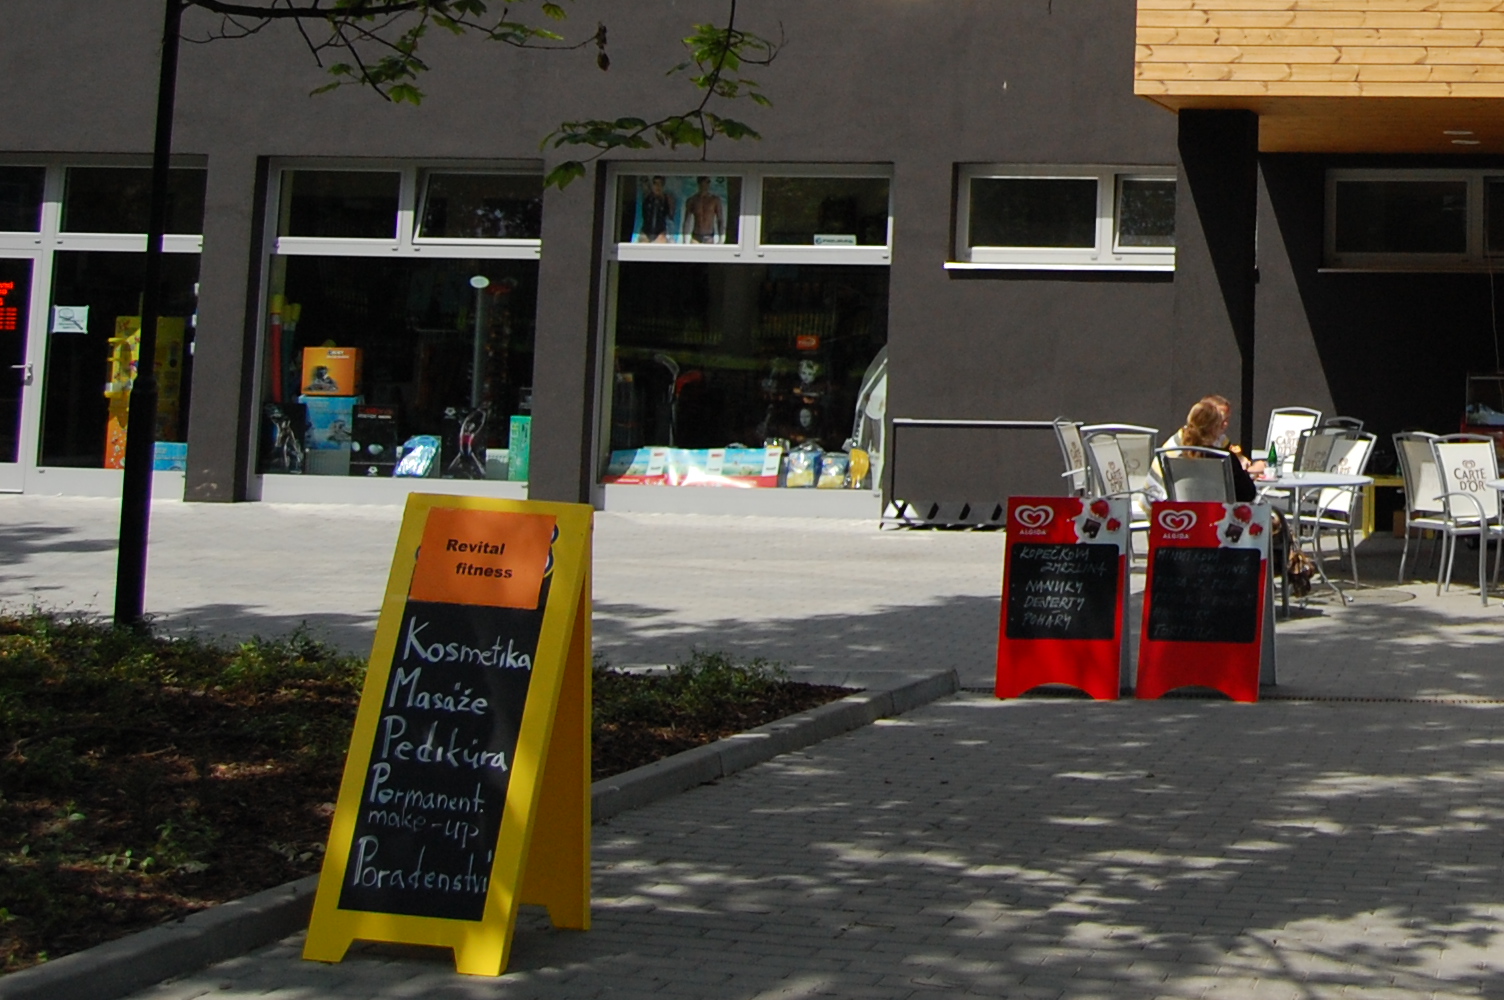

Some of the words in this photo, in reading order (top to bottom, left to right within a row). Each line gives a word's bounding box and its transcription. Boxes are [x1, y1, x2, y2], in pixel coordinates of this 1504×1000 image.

[1453, 467, 1486, 482] CARTE
[1459, 479, 1486, 493] D'OR
[1019, 528, 1047, 536] ALGIDA
[1162, 532, 1190, 540] ALGIDA
[446, 538, 506, 555] Revital
[455, 562, 513, 579] fitness
[1026, 579, 1084, 595] NANUKY
[403, 615, 532, 671] Kosmetika
[388, 666, 489, 716] Masáže
